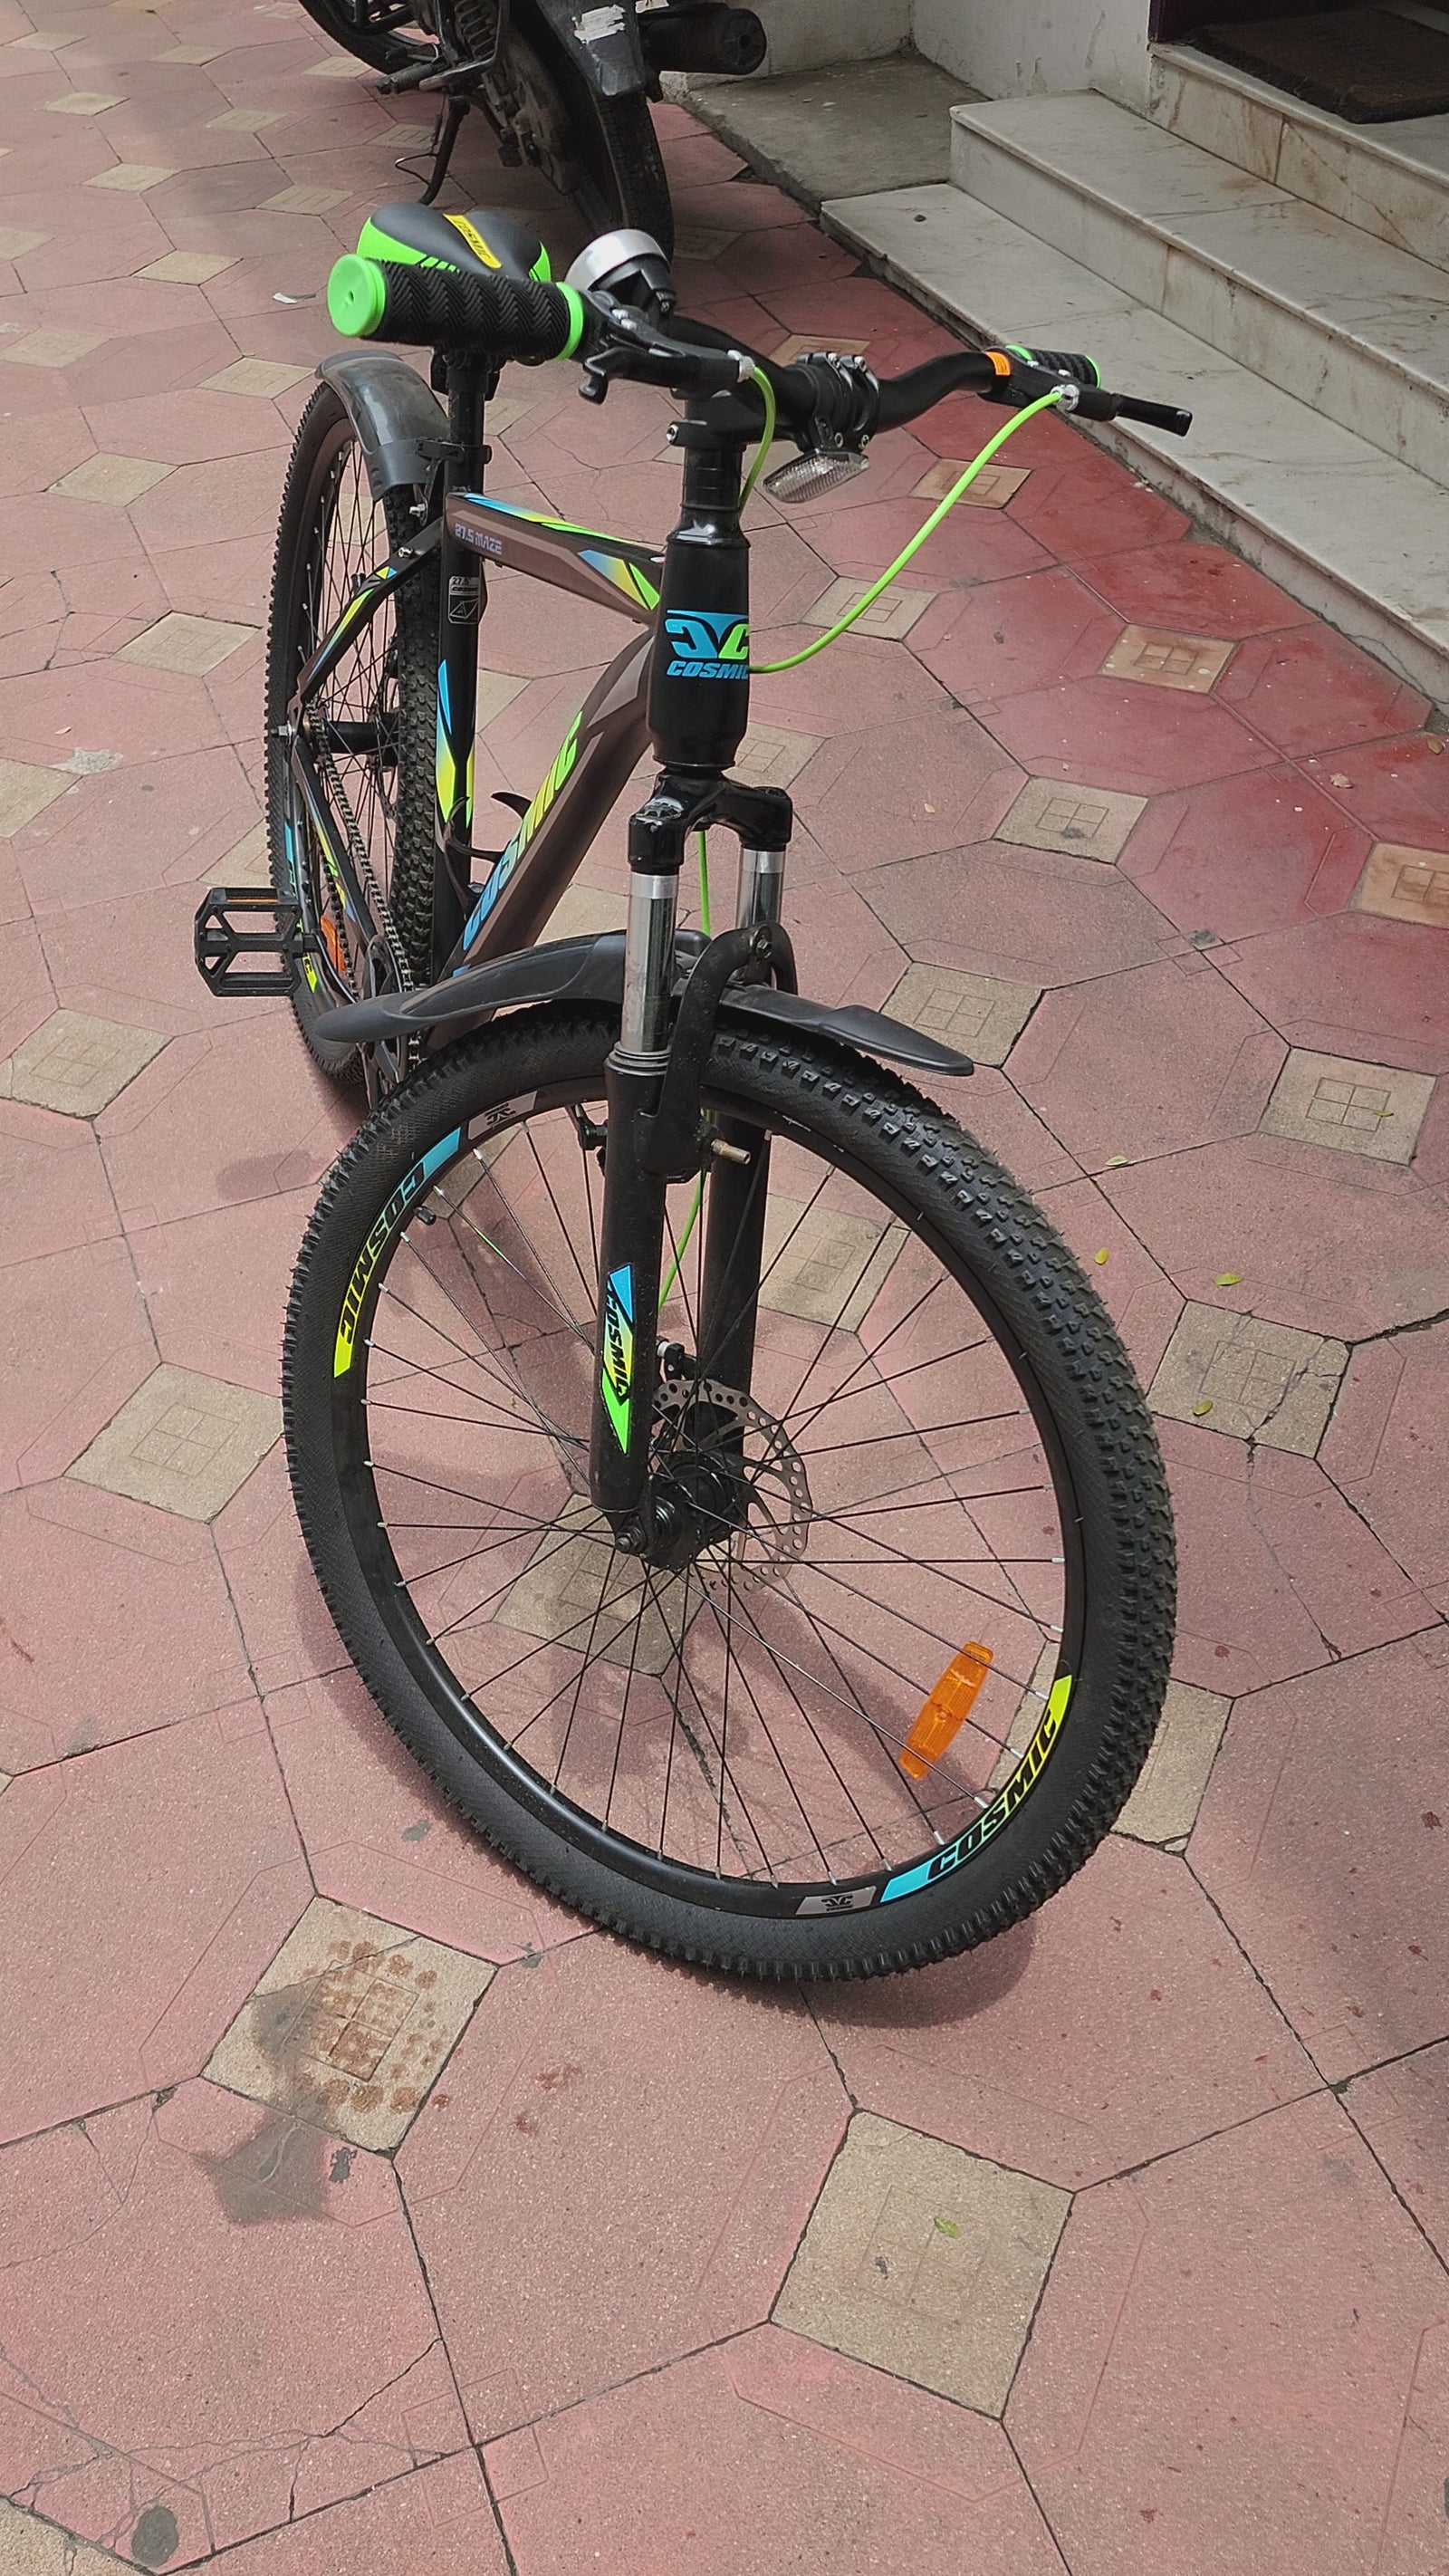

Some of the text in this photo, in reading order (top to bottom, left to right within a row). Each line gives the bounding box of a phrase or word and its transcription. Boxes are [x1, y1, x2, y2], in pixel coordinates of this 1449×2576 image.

[455, 523, 503, 556] 27.5 MAZE
[341, 1160, 426, 1346] COSMIC
[926, 1707, 1058, 1881] COSMIC
